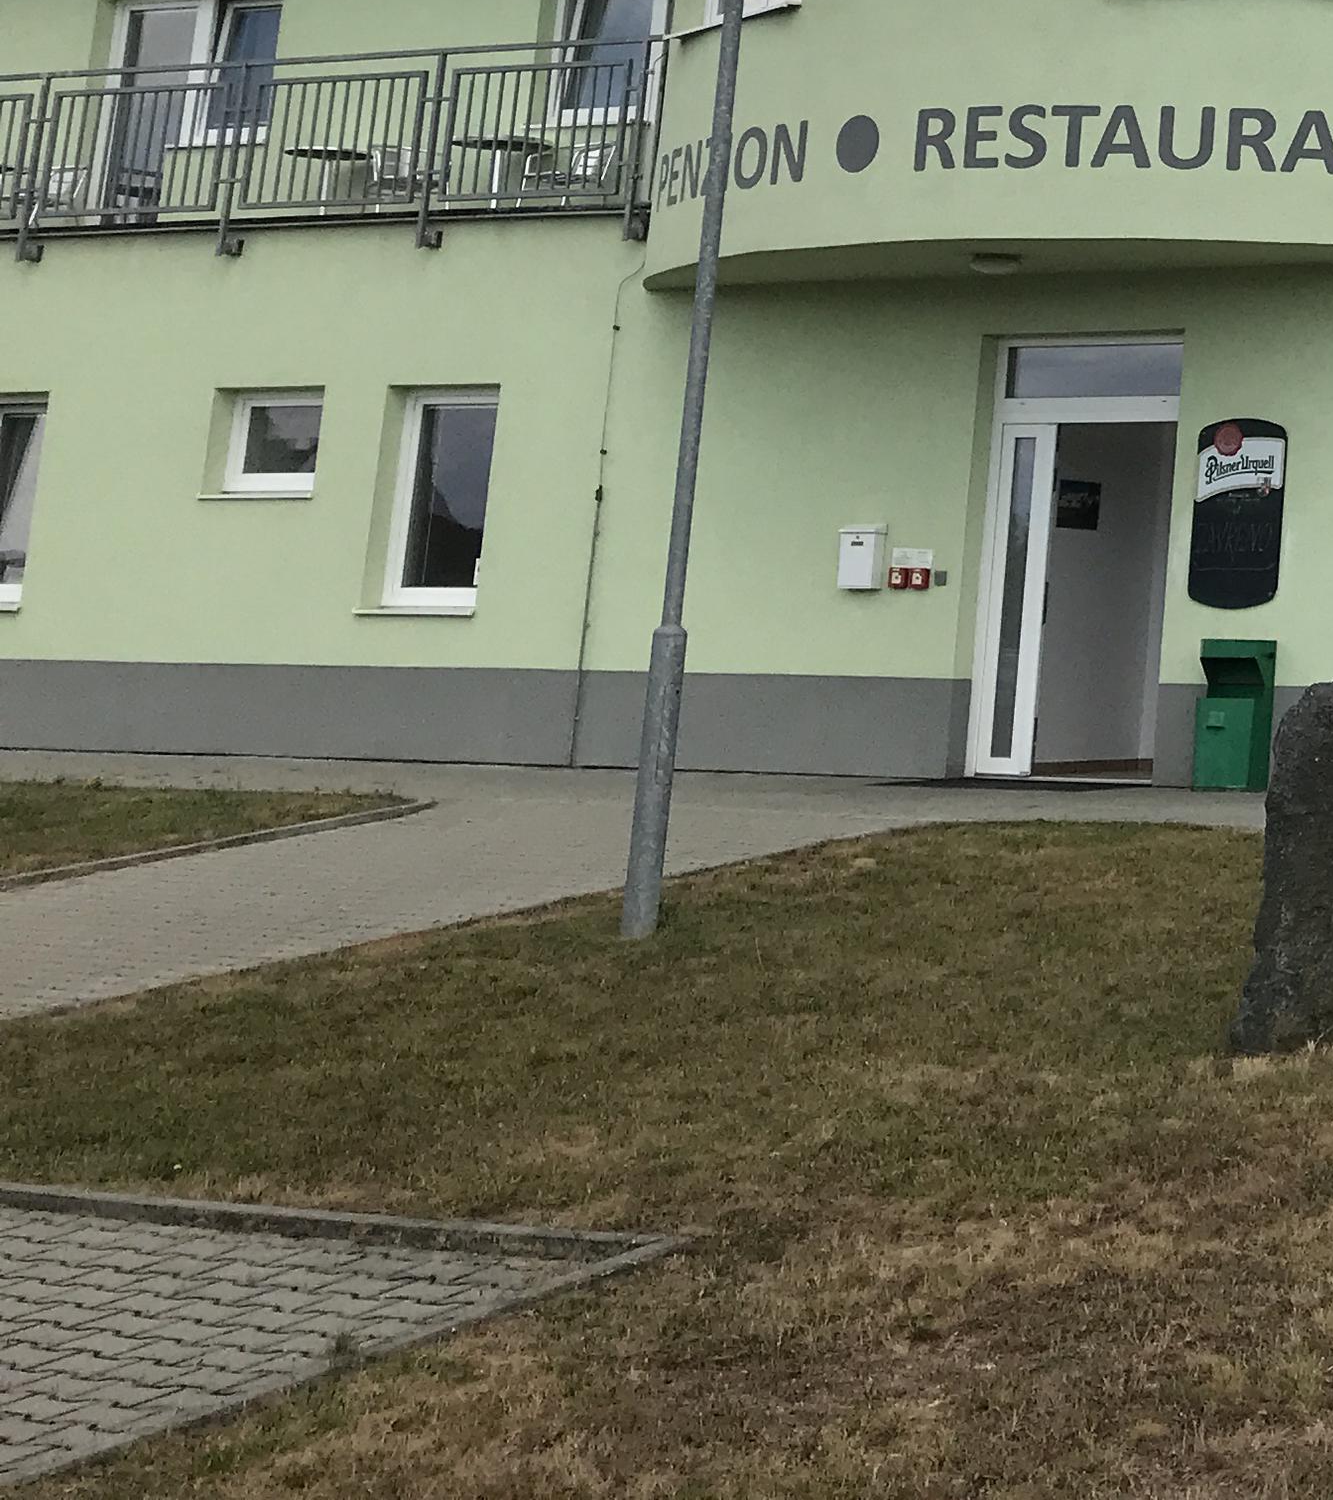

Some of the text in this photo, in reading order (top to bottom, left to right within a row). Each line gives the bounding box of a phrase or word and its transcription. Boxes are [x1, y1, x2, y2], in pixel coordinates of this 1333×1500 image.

[656, 119, 809, 212] PENON
[1204, 454, 1275, 485] Pilsner Urquell
